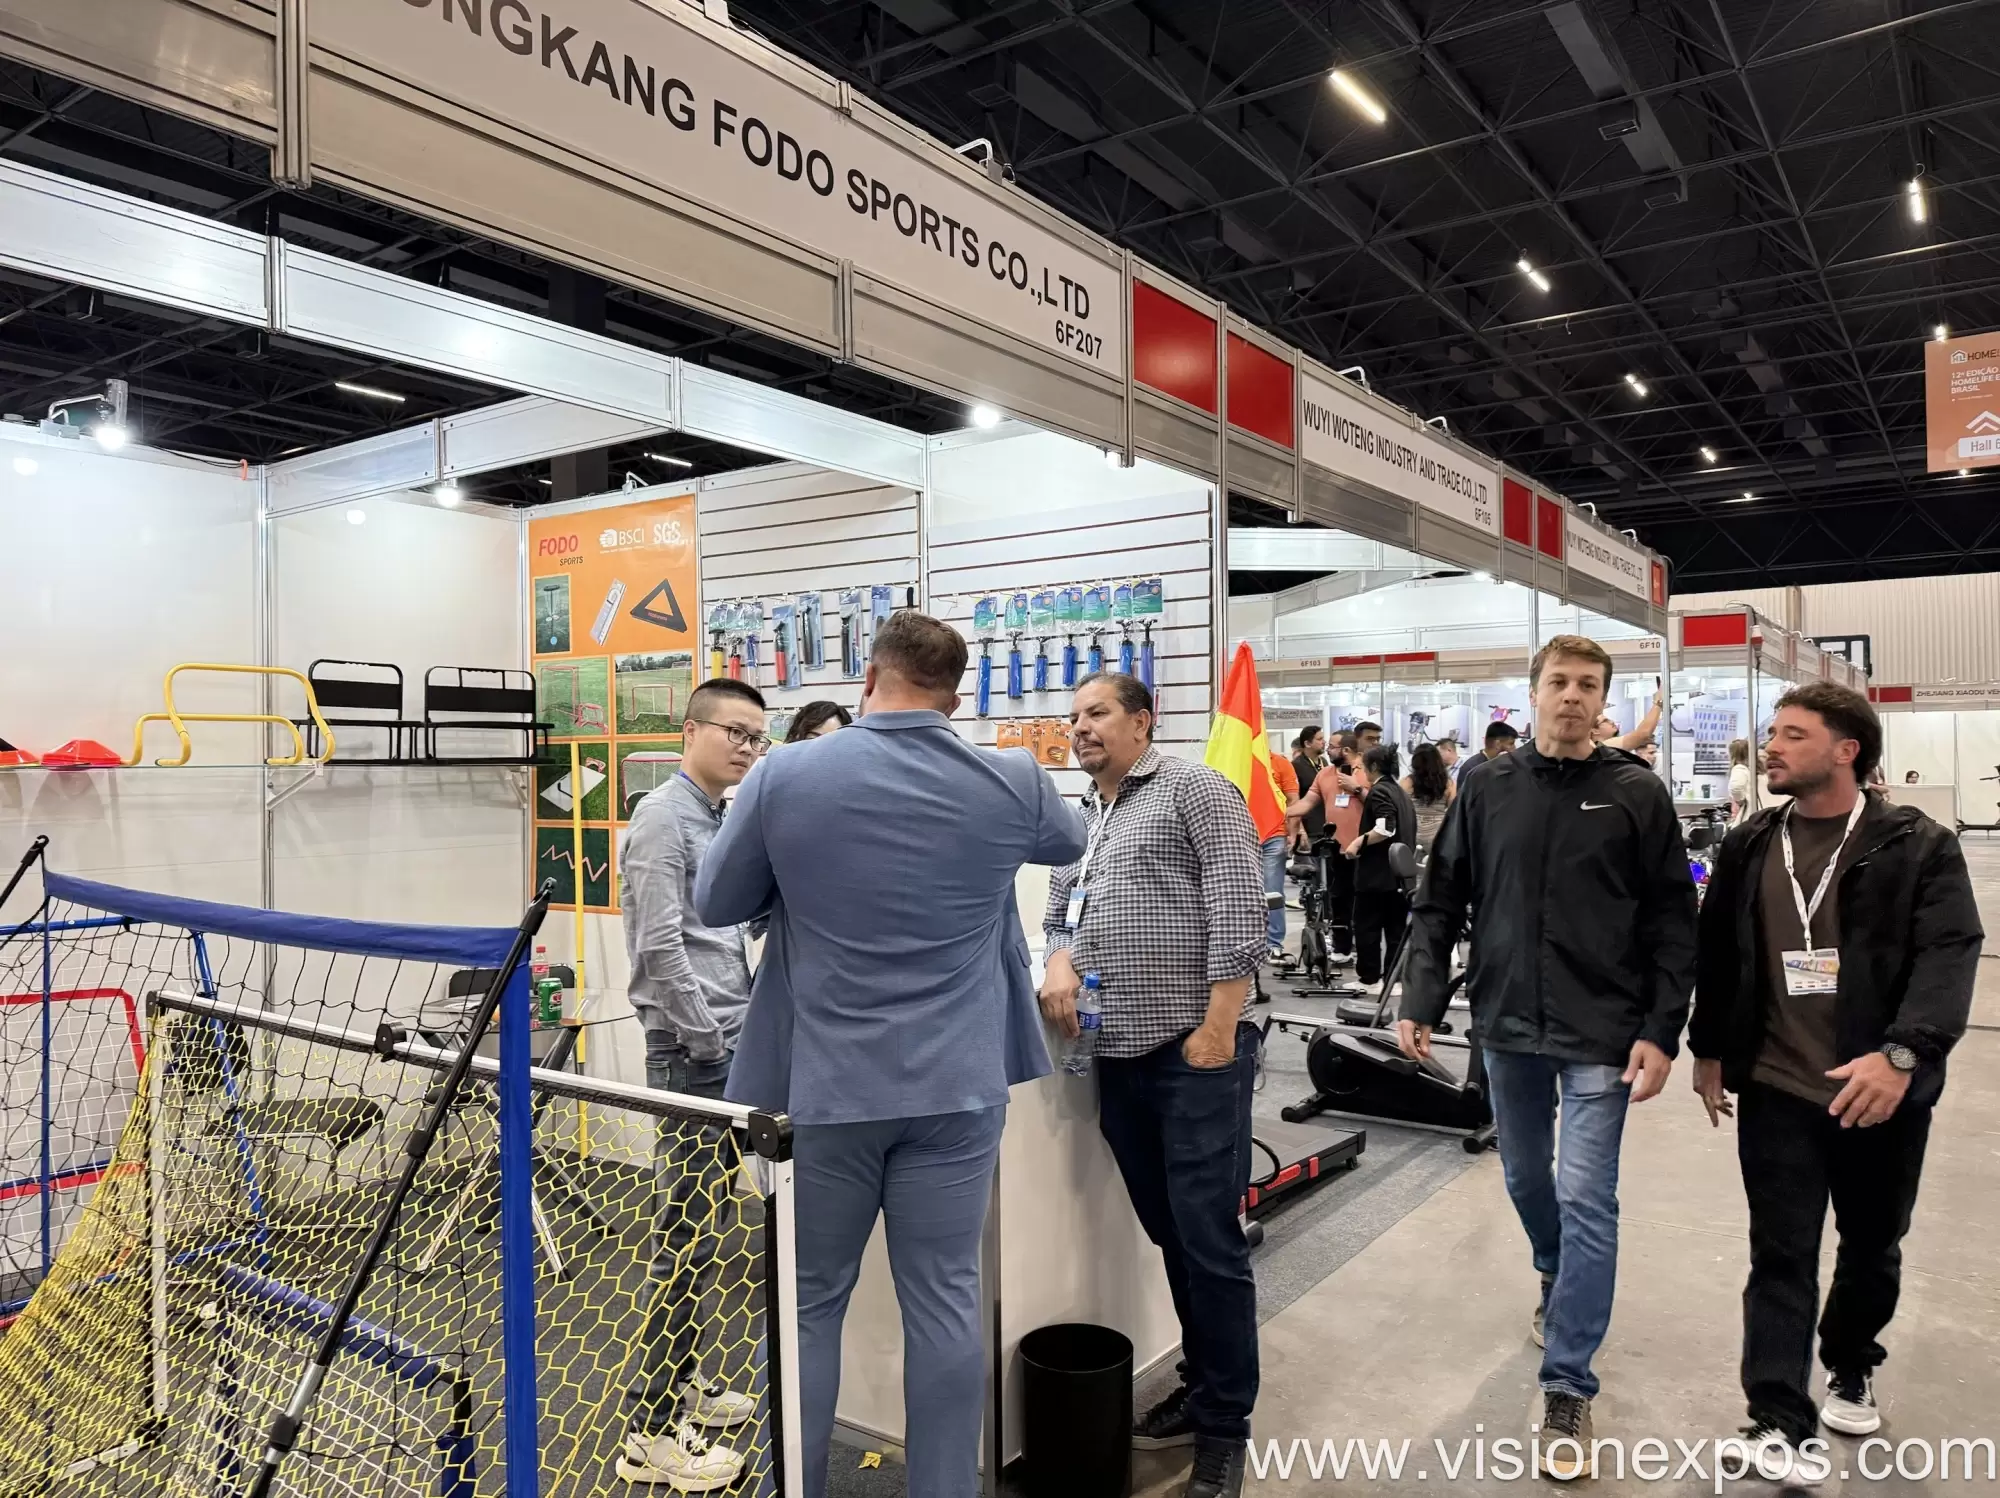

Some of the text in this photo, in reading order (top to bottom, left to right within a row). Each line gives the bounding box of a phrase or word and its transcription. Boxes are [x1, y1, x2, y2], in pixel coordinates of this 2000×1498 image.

[402, 0, 1091, 320] NGKANG FODO SPORTS CO.,LTD
[1054, 318, 1103, 360] 6F207
[1951, 374, 1994, 387] HOMELIFE
[1951, 384, 1981, 394] BRASIL
[1303, 399, 1331, 436] WUYI
[1332, 412, 1374, 455] WOTENG
[1375, 433, 1418, 474] INDUSTRY
[1419, 455, 1436, 482] AND
[1437, 463, 1461, 494] TRADE
[1970, 439, 1992, 453] Hall
[618, 528, 645, 546] BSCI
[653, 519, 681, 545] SGS
[538, 534, 579, 557] FODO
[559, 555, 584, 566] SPORTS
[1640, 641, 1661, 650] 6F10
[1300, 660, 1322, 668] 6F103
